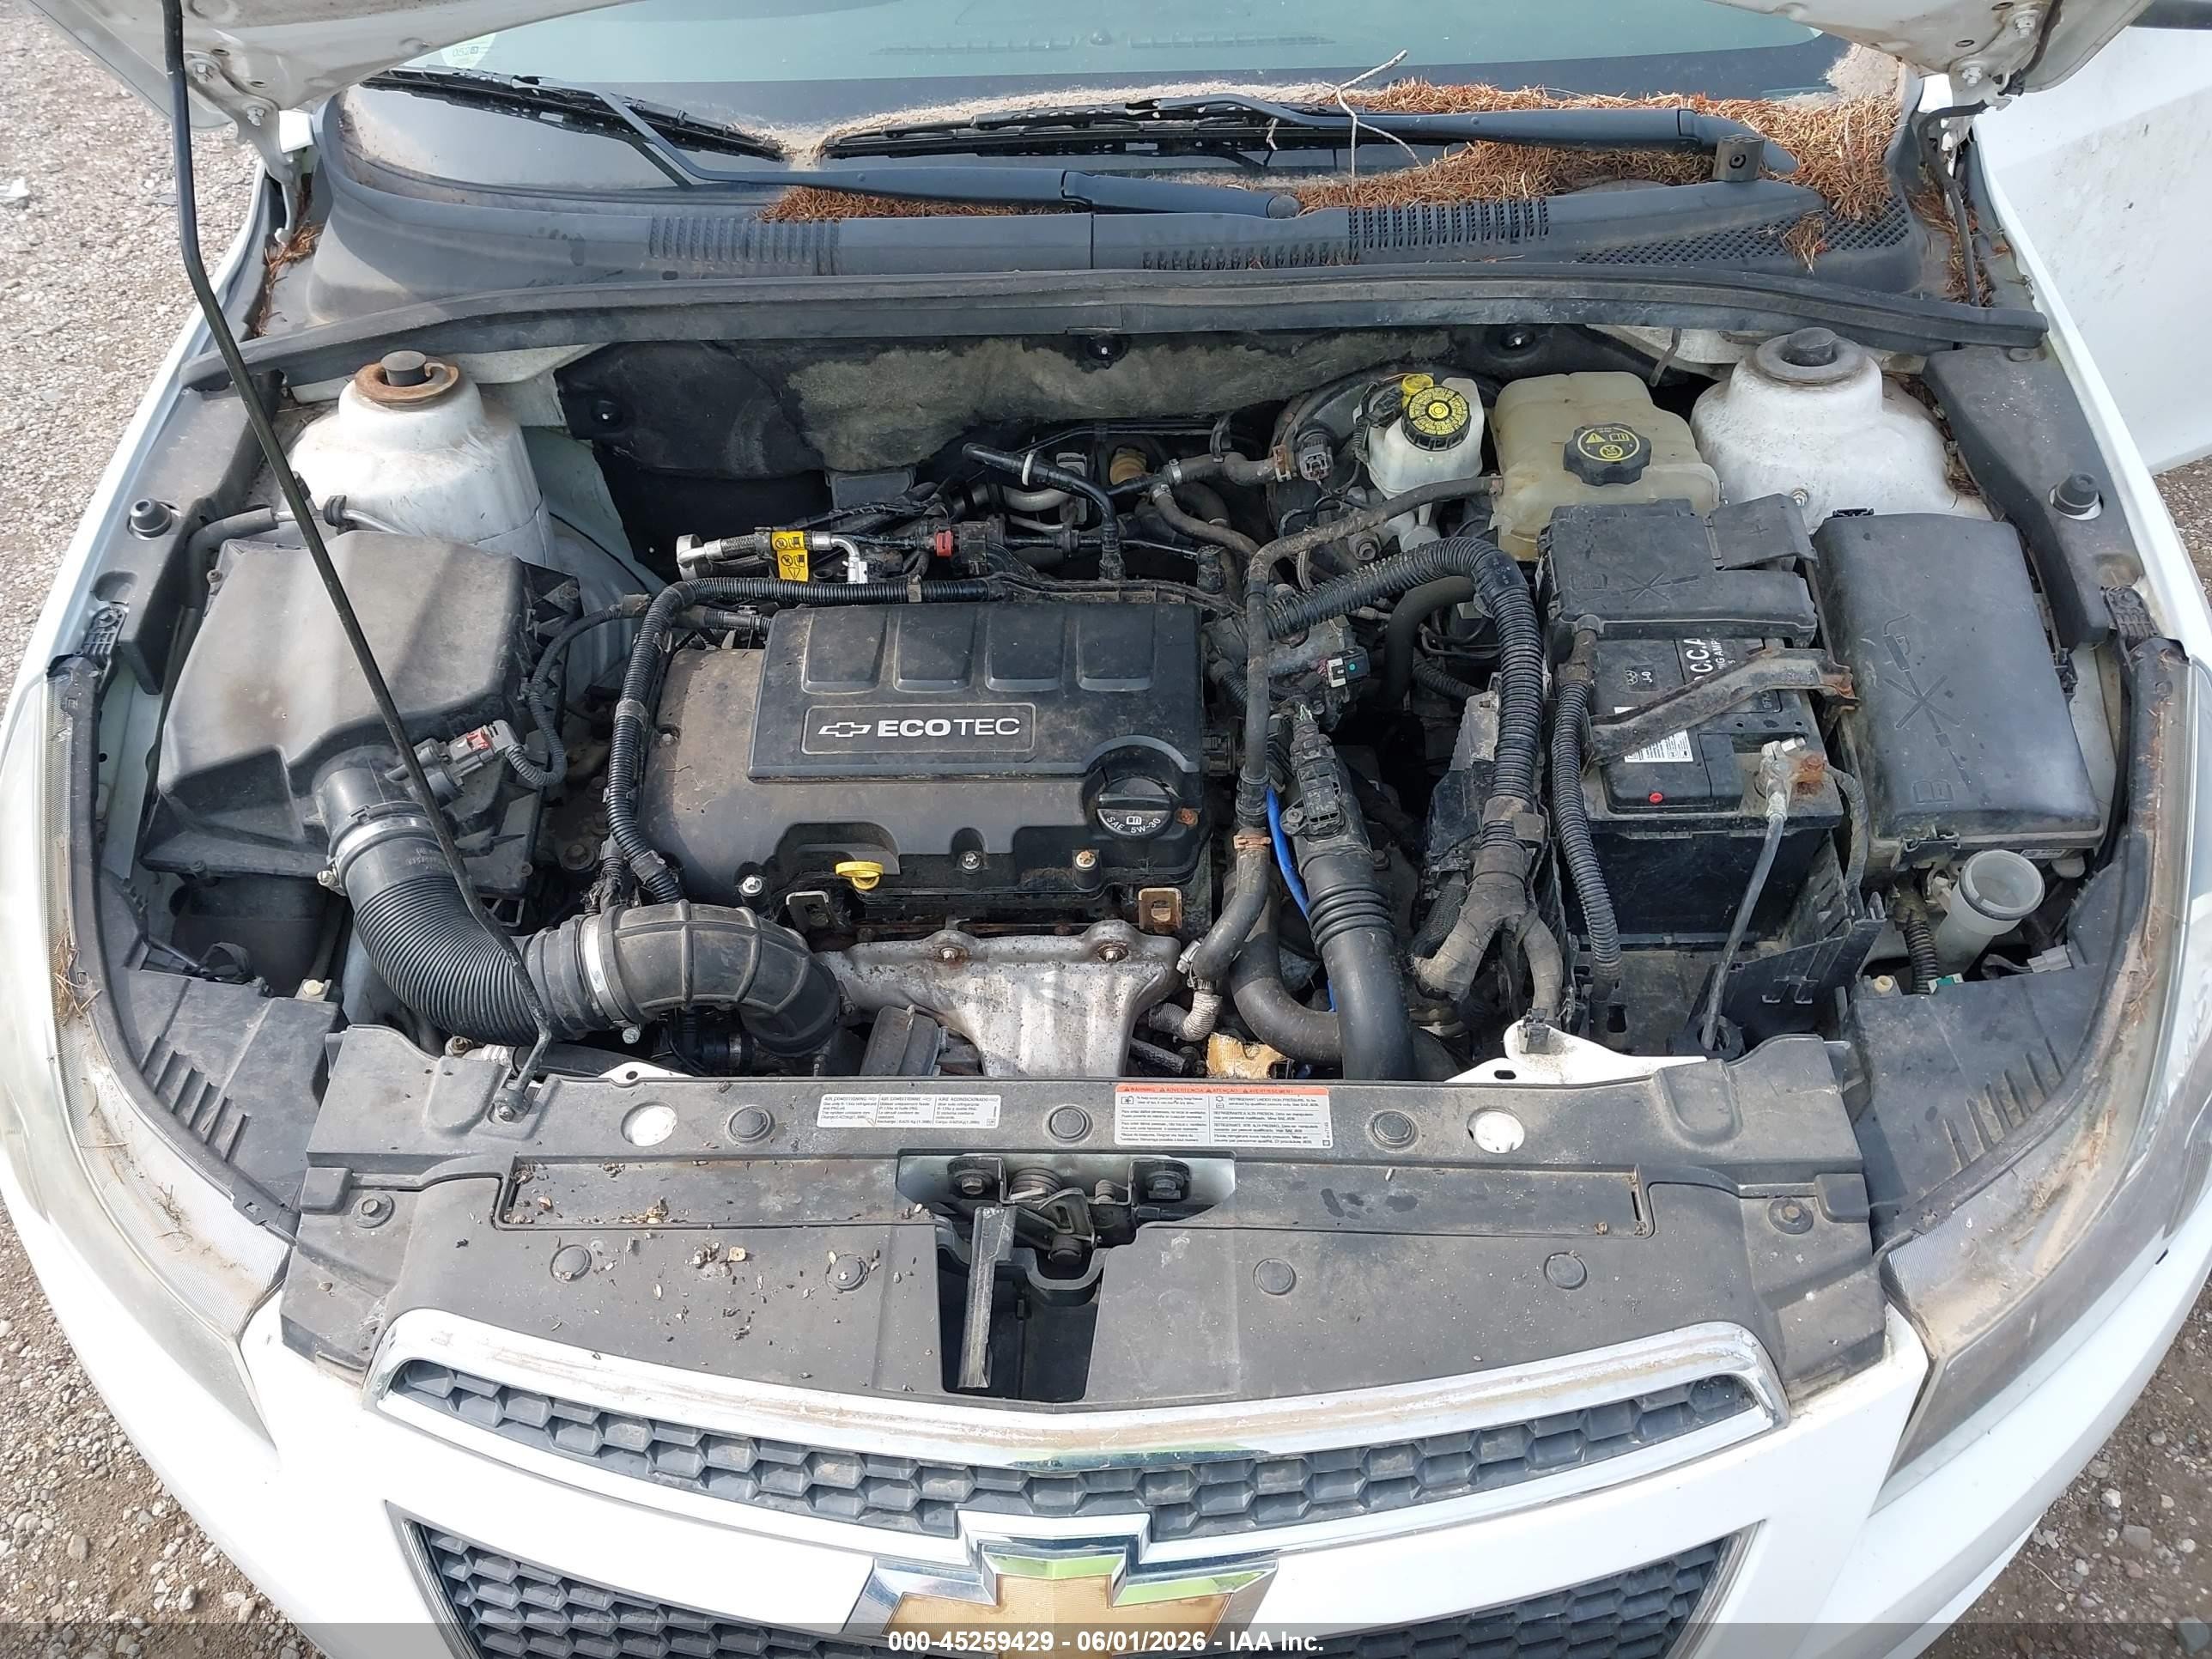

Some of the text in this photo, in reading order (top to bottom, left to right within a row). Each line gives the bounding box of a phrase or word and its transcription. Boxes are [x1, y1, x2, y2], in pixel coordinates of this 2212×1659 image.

[877, 718, 1020, 737] ECOTEC
[1106, 816, 1161, 834] SAE 5W-30
